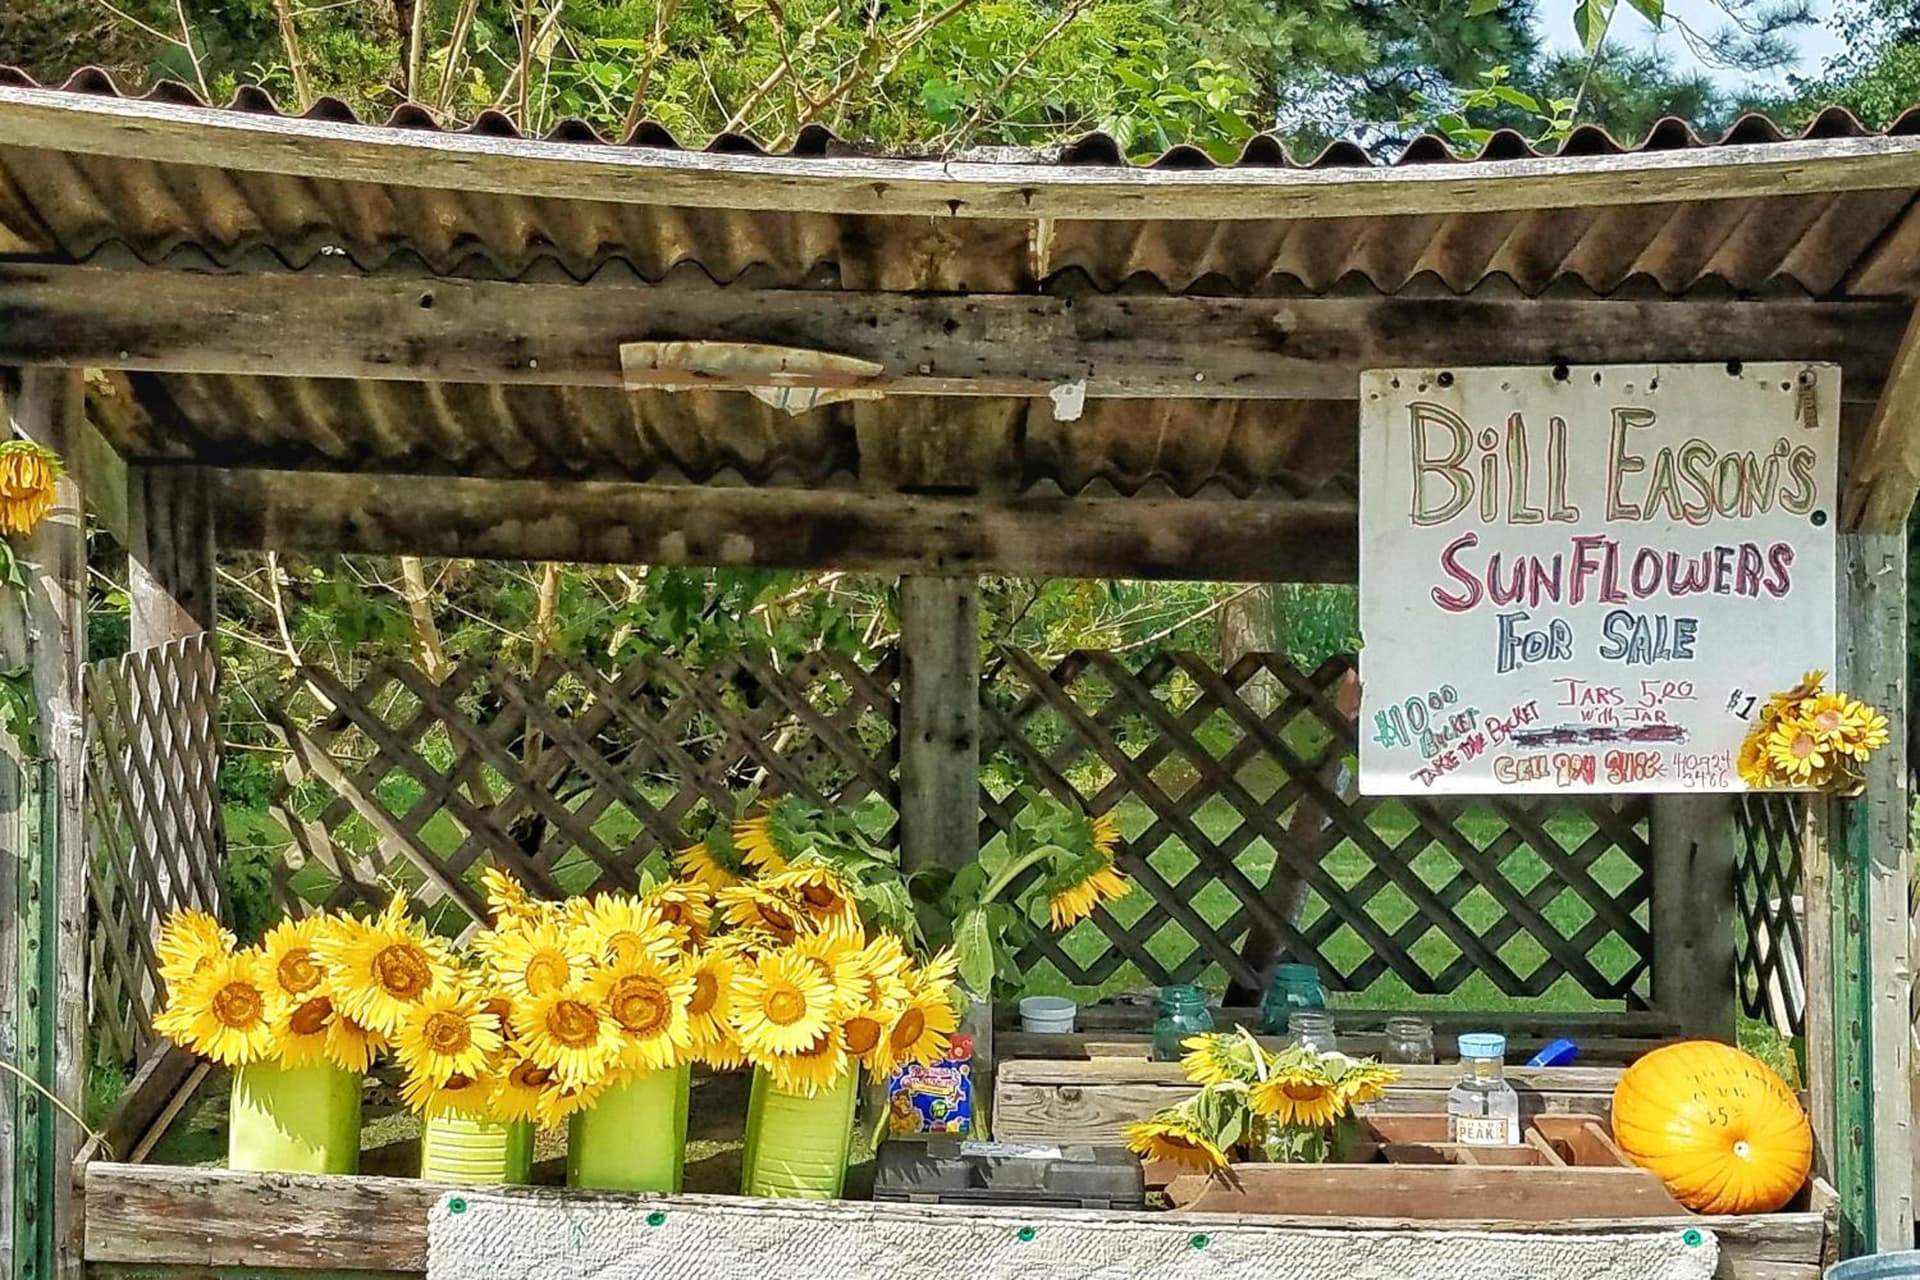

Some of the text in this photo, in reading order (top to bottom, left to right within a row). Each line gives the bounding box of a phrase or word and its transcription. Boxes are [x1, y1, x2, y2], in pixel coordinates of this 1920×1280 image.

[1406, 401, 1817, 525] BiLL EASON'S
[1431, 532, 1795, 612] SUNFLOWERS
[1496, 610, 1698, 673] FOR SALE
[1553, 678, 1624, 706] JARS
[1624, 707, 1668, 723] JAR
[1410, 750, 1460, 787] TAKE
[1485, 700, 1540, 747] BUCKET
[1459, 1127, 1494, 1140] PEAK
